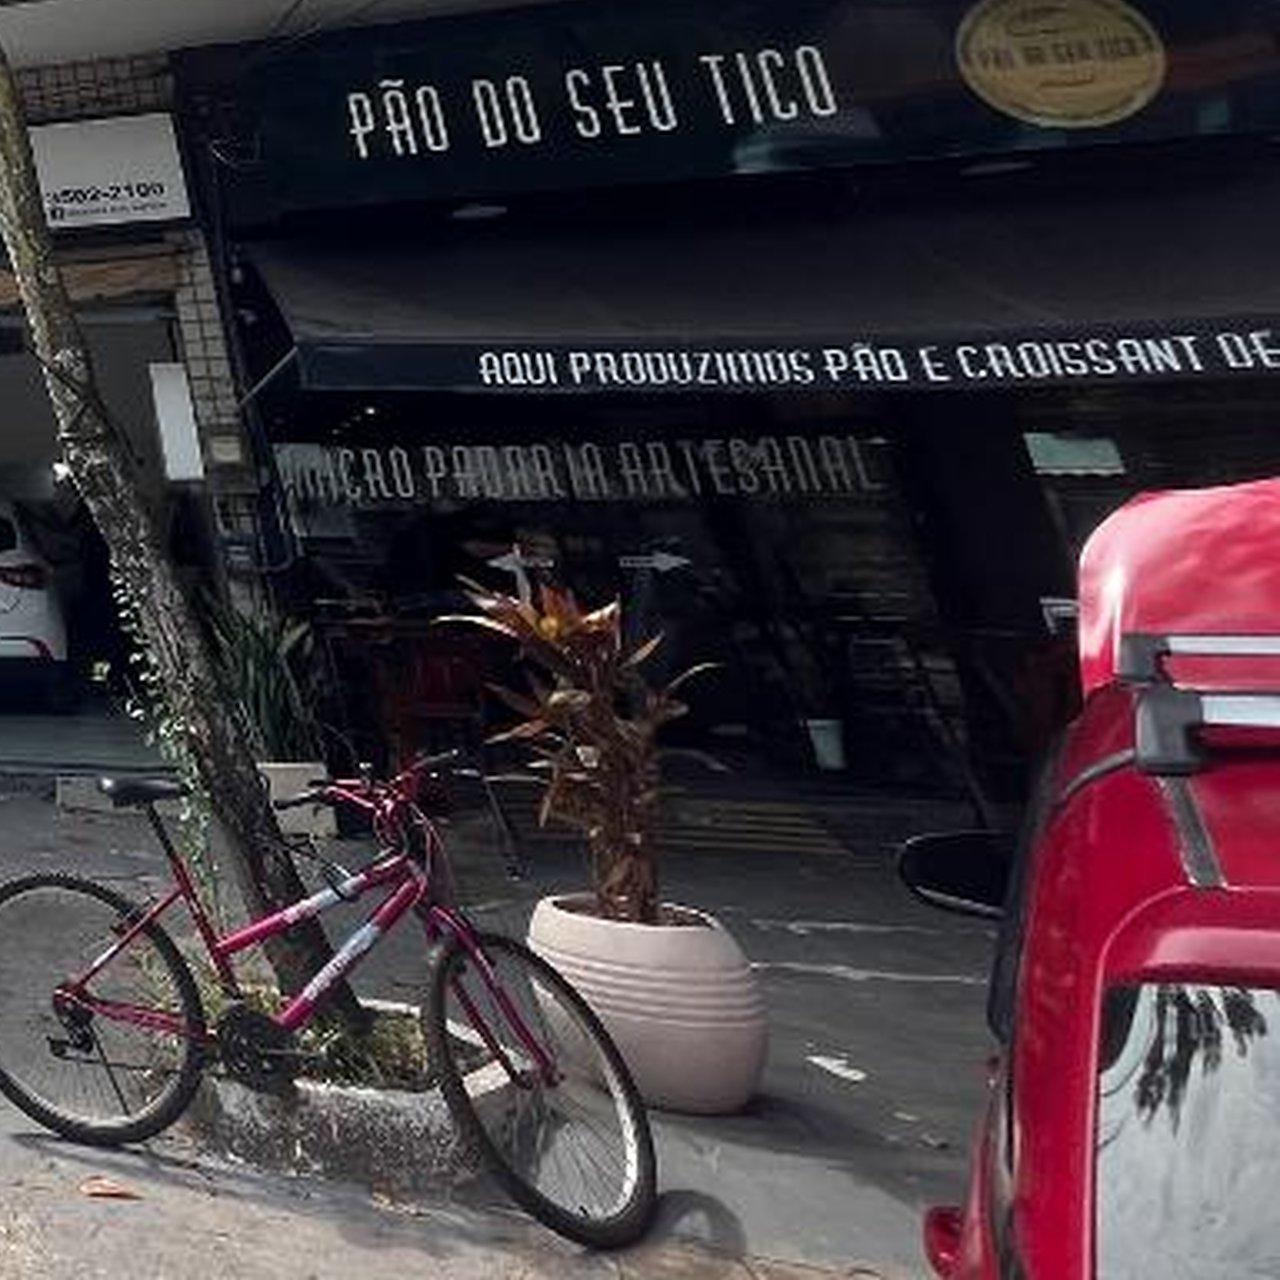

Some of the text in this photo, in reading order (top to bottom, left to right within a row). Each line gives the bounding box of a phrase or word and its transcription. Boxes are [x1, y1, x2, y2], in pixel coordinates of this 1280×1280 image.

[347, 44, 838, 158] PÃO DO SEU TICO
[478, 329, 1280, 385] AQUI PRODUZIMOS PÃO E CROISSANT DE
[424, 442, 610, 500] PADARIA
[617, 435, 886, 498] ARTESANAL
